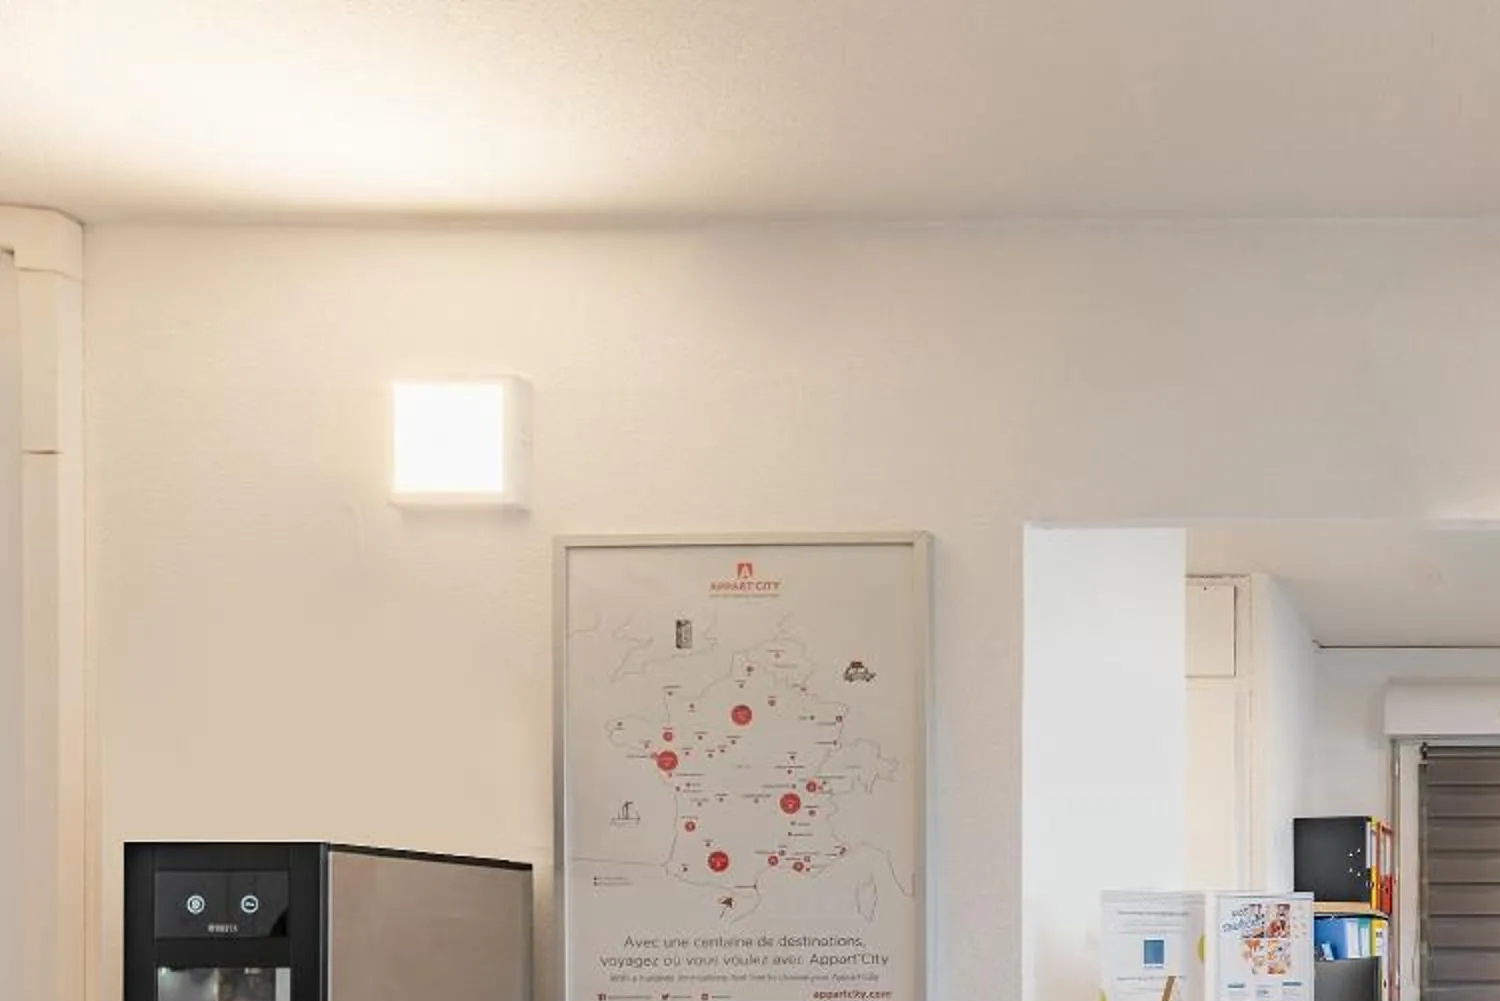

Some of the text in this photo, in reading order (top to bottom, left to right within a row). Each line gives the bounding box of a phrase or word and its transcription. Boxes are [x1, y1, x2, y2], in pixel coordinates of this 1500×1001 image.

[624, 936, 658, 948] Avec
[757, 936, 774, 948] de
[600, 956, 658, 969] voyagez
